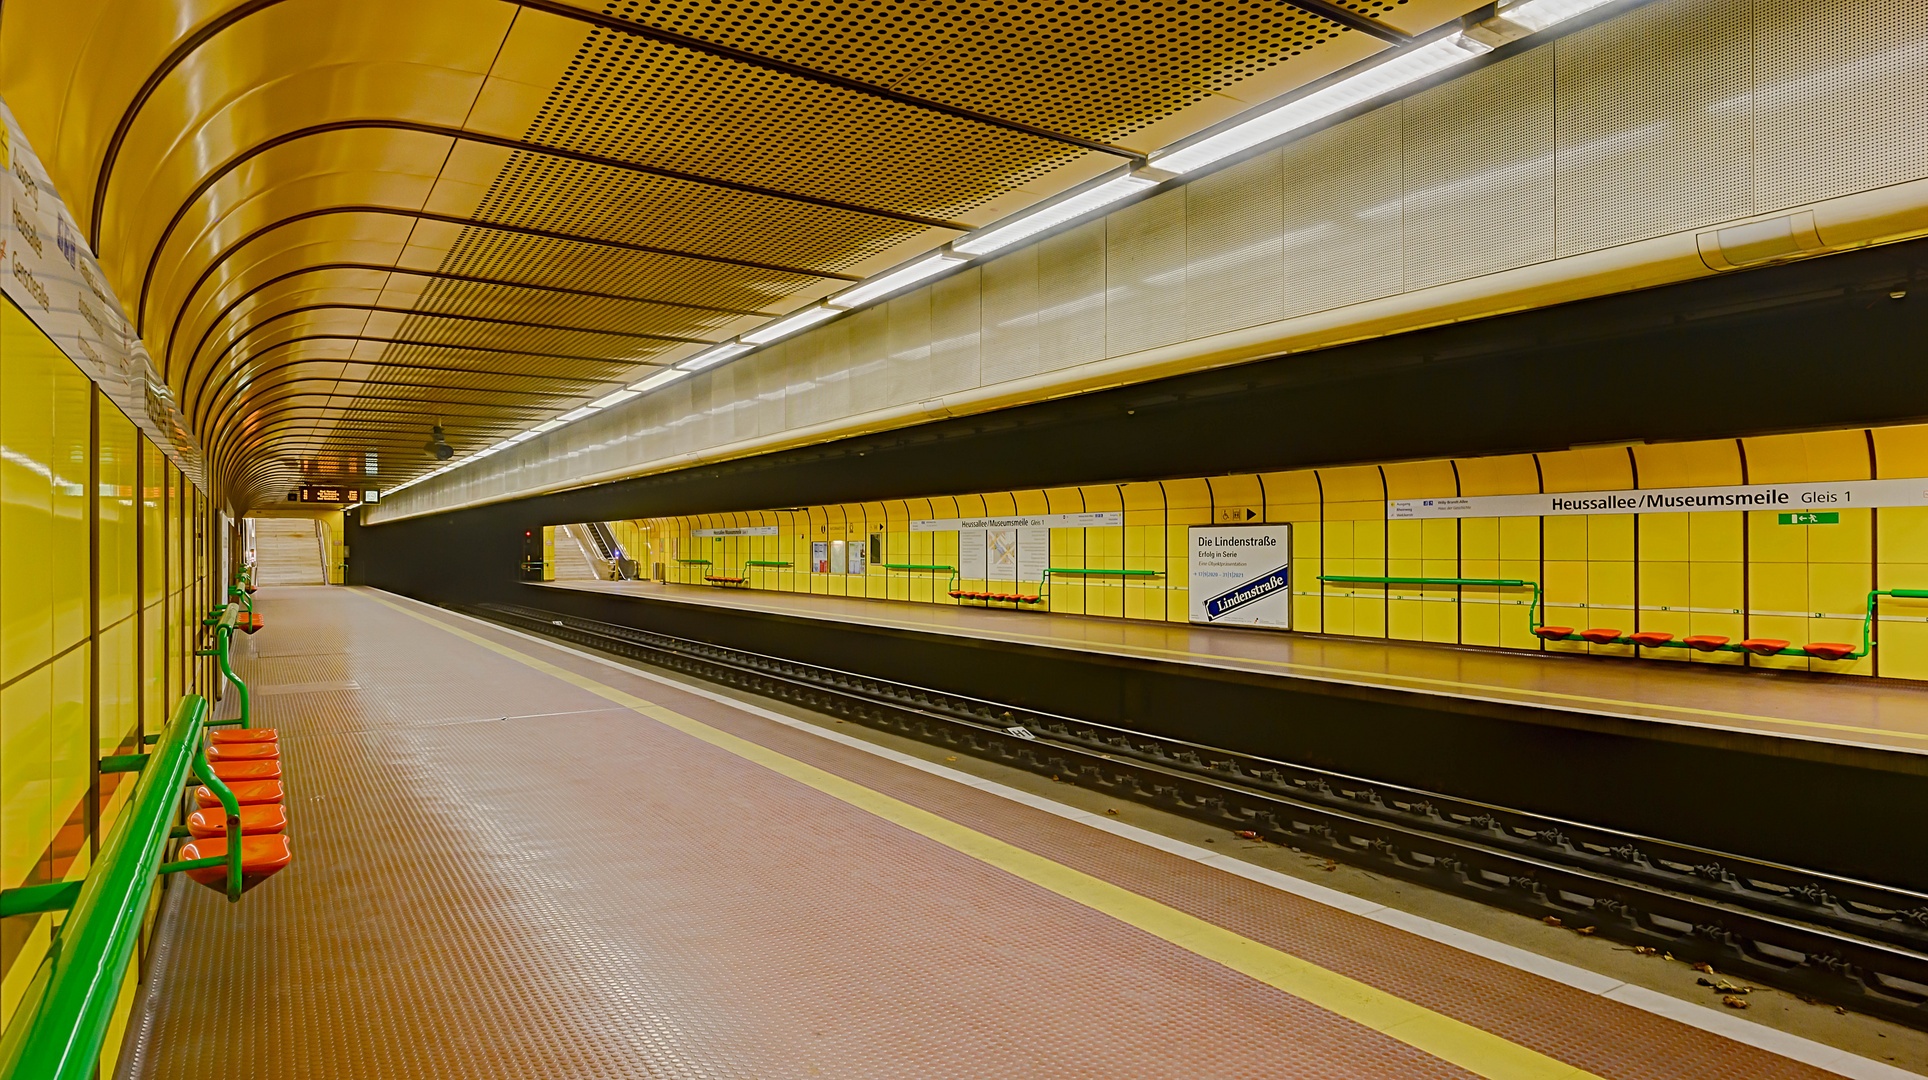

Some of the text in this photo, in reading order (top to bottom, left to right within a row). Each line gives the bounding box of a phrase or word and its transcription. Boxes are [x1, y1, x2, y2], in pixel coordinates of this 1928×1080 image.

[1551, 490, 1852, 511] Heussallee/Museumsmeile Gleis 1
[961, 518, 1029, 528] Heussallee/Museumsmeile
[1198, 535, 1277, 547] Die Lindenstraße
[1198, 551, 1215, 559] Erfolg
[1217, 576, 1284, 612] Lindenstraße
[1012, 729, 1031, 737] H1
